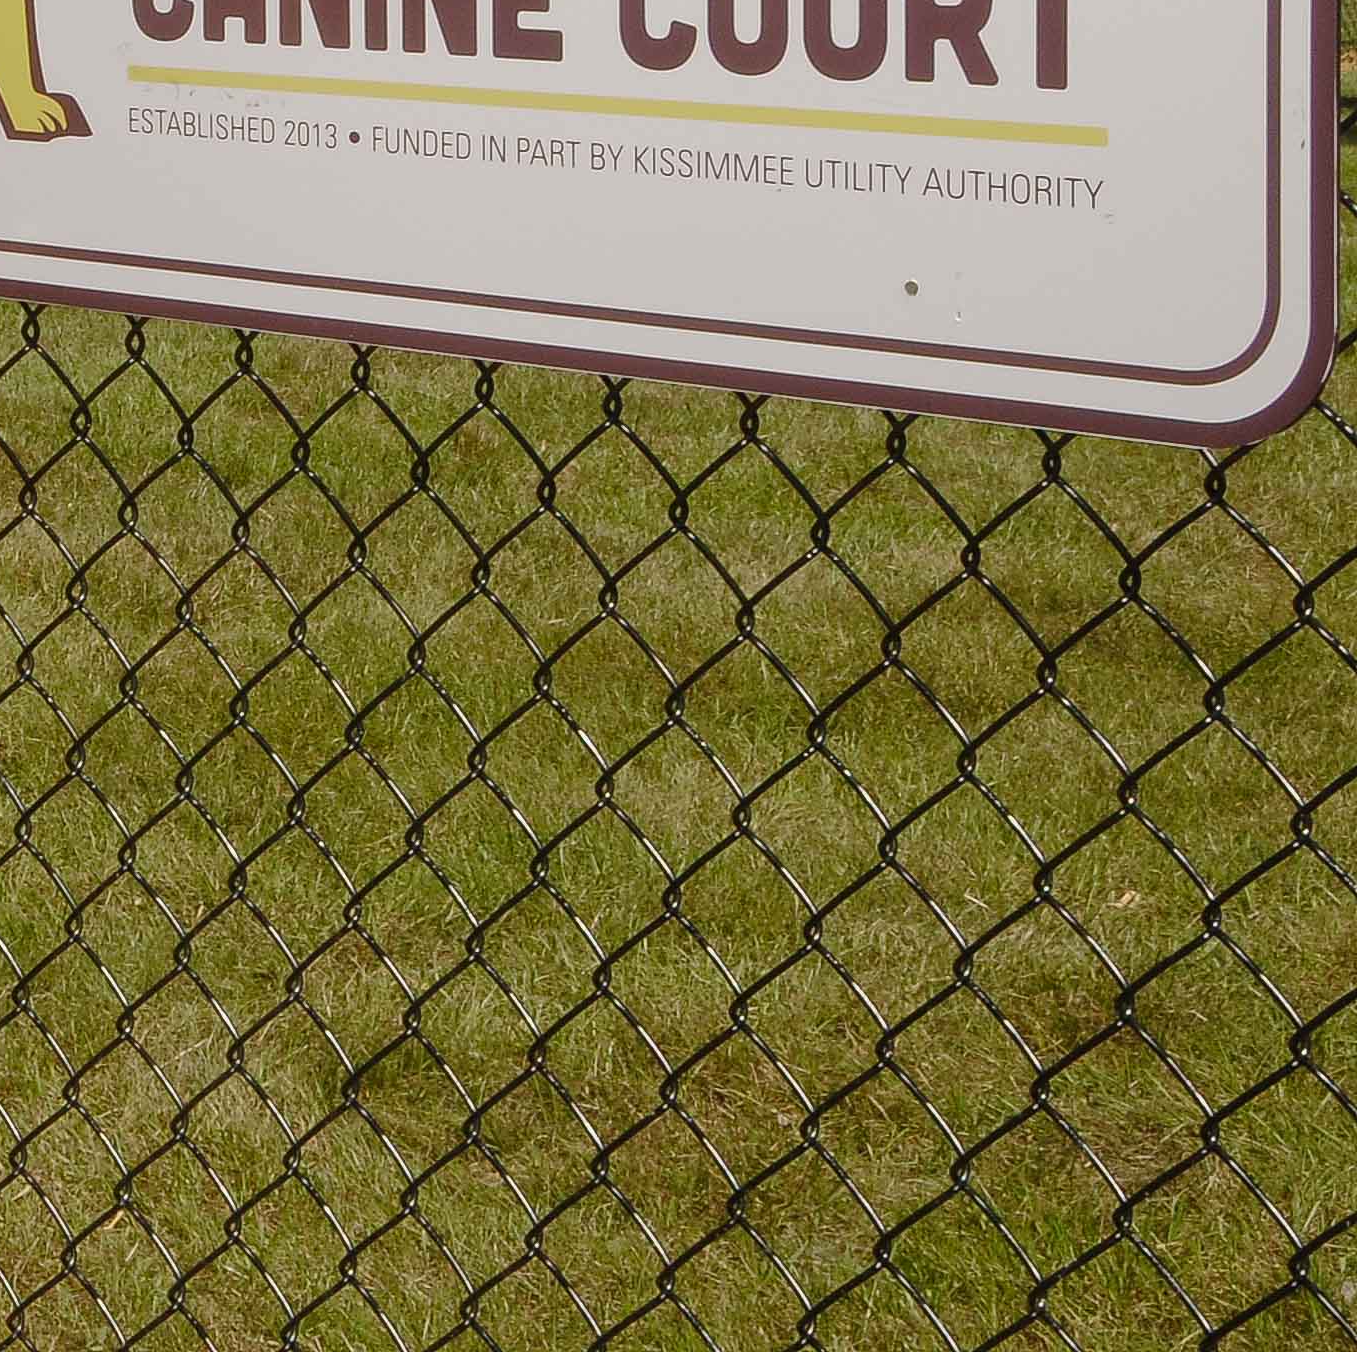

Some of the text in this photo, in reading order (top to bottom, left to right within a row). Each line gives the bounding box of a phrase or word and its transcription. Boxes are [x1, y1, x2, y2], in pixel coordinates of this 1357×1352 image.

[128, 107, 1104, 210] ESTABLISHED 2013 FUNDED IN PART BY KISSIMMEE UTILITY AUTHORITY
